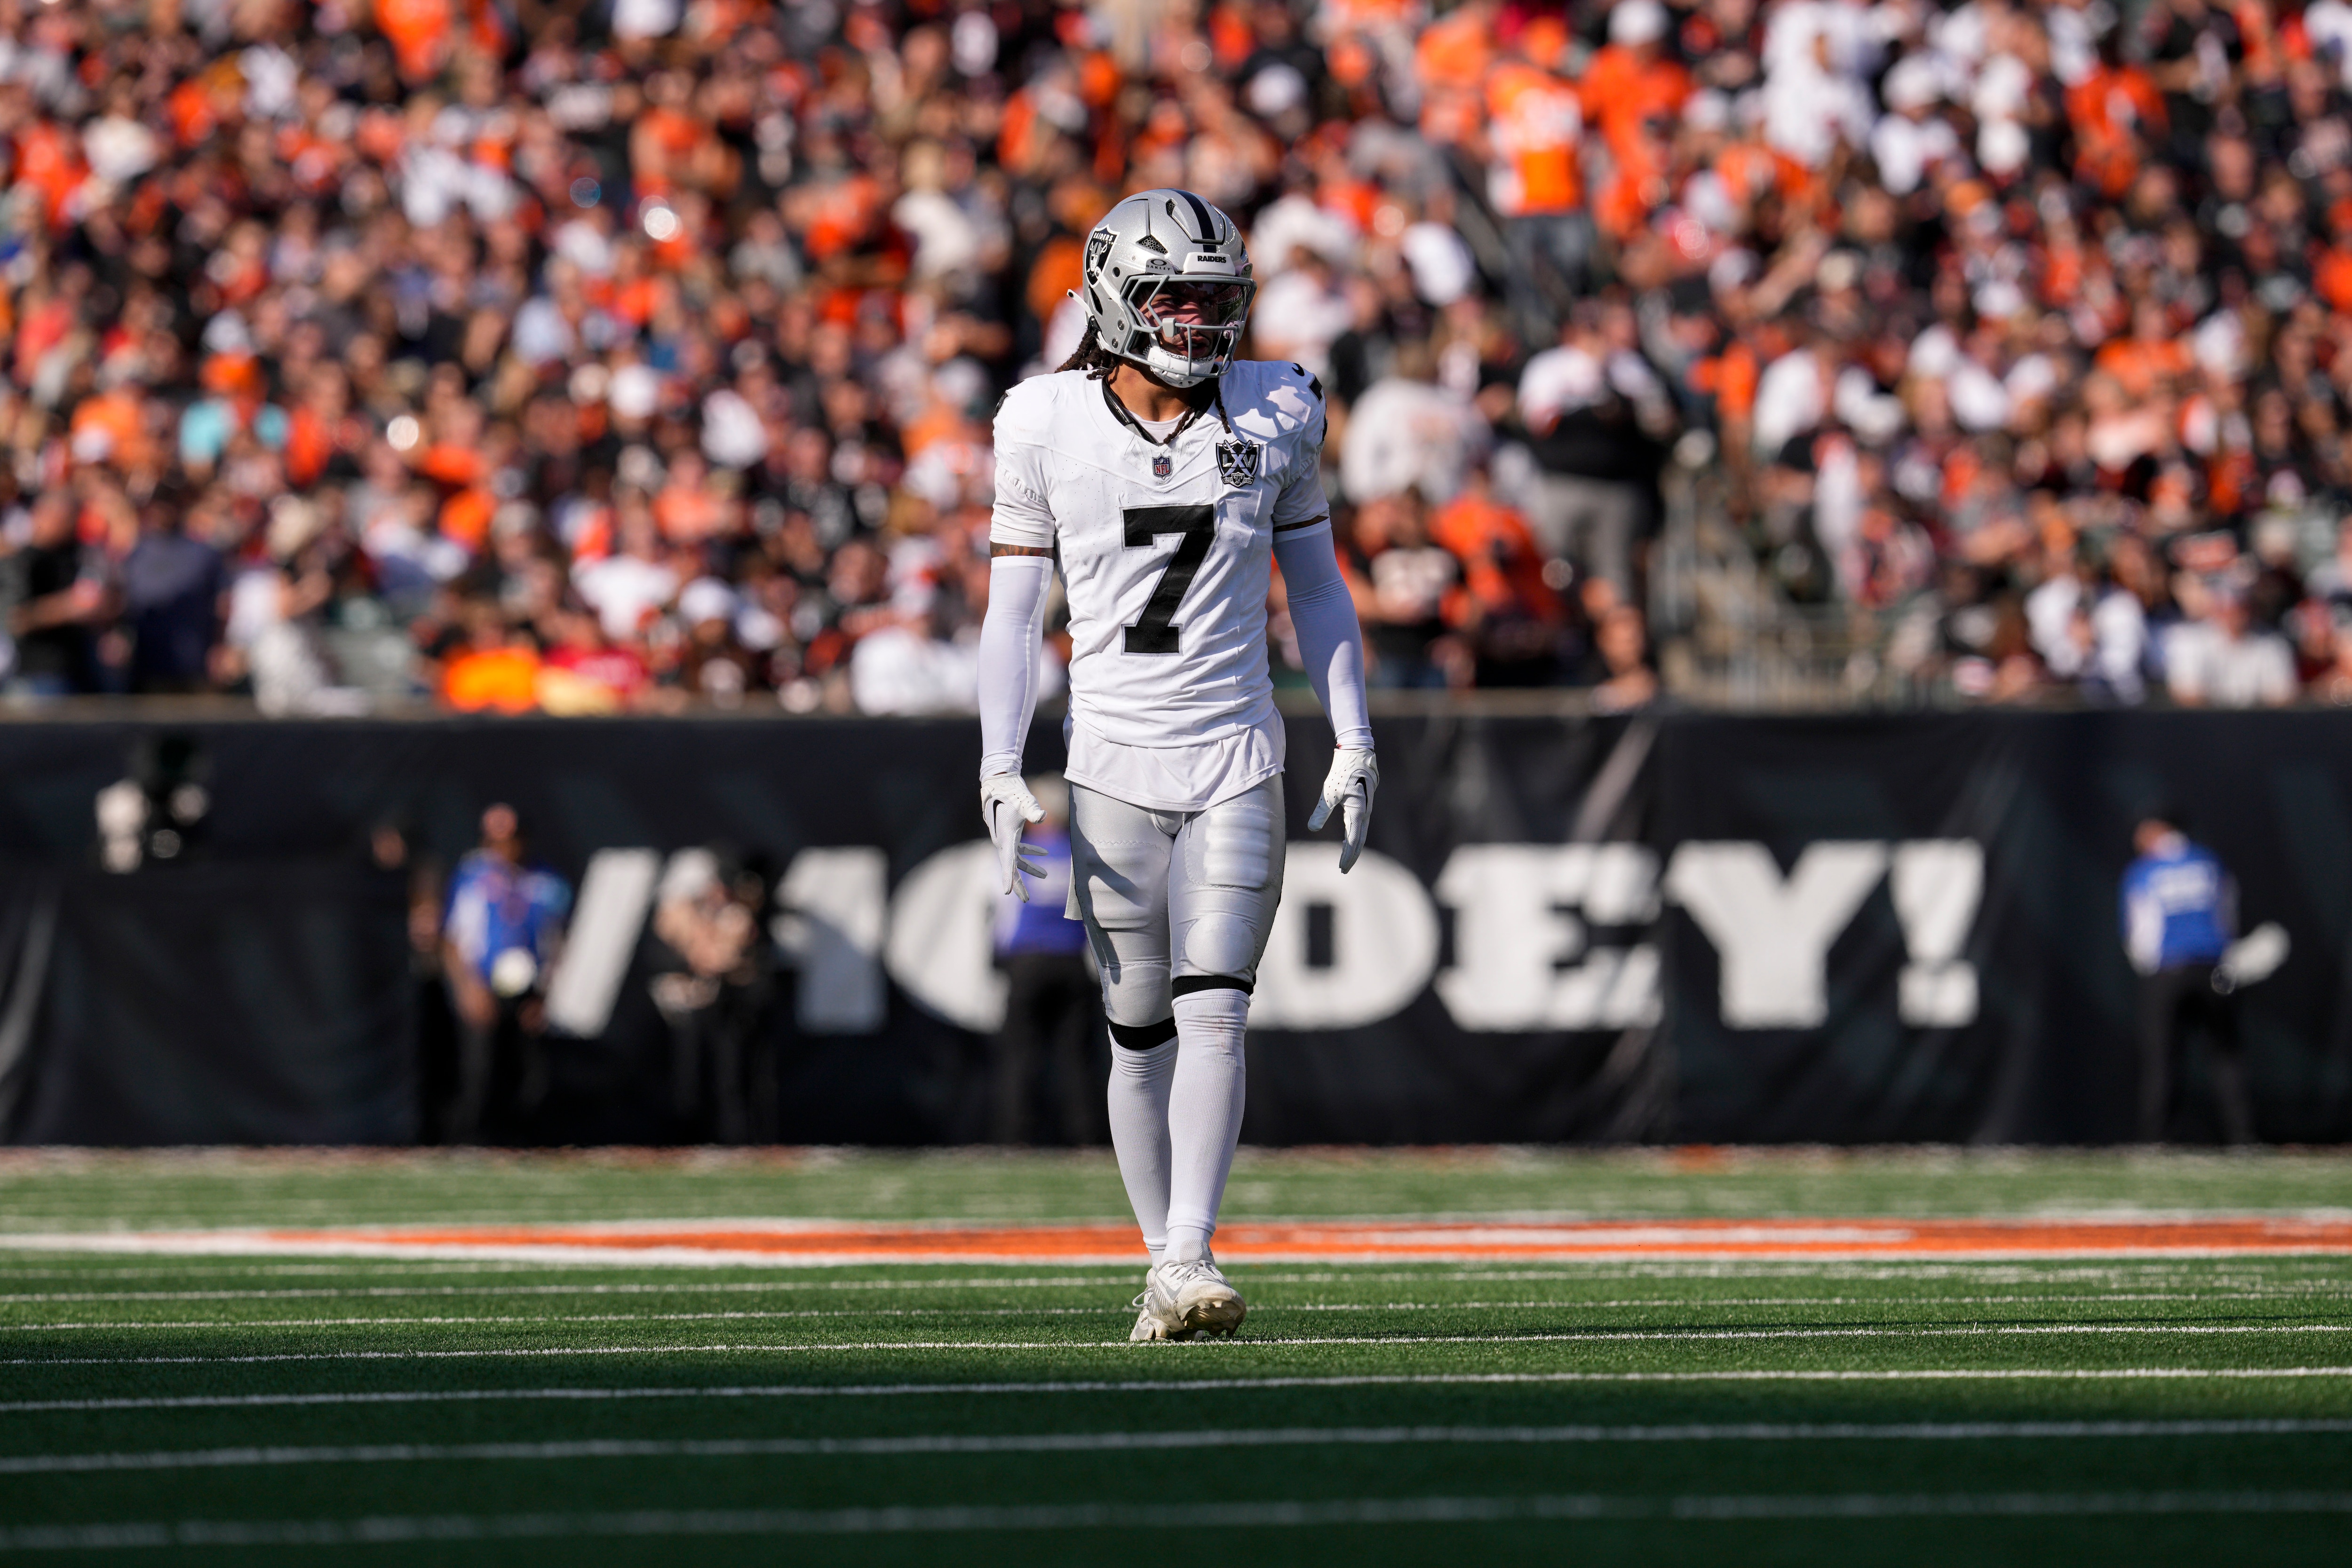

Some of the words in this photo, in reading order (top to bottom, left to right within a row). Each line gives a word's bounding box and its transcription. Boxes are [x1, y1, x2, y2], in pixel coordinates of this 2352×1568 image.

[1093, 232, 1113, 242] RAIDERS
[1222, 454, 1256, 468] LXV
[1155, 465, 1169, 475] NFL
[1120, 503, 1218, 656] 7
[1247, 841, 1986, 1030] DEY!
